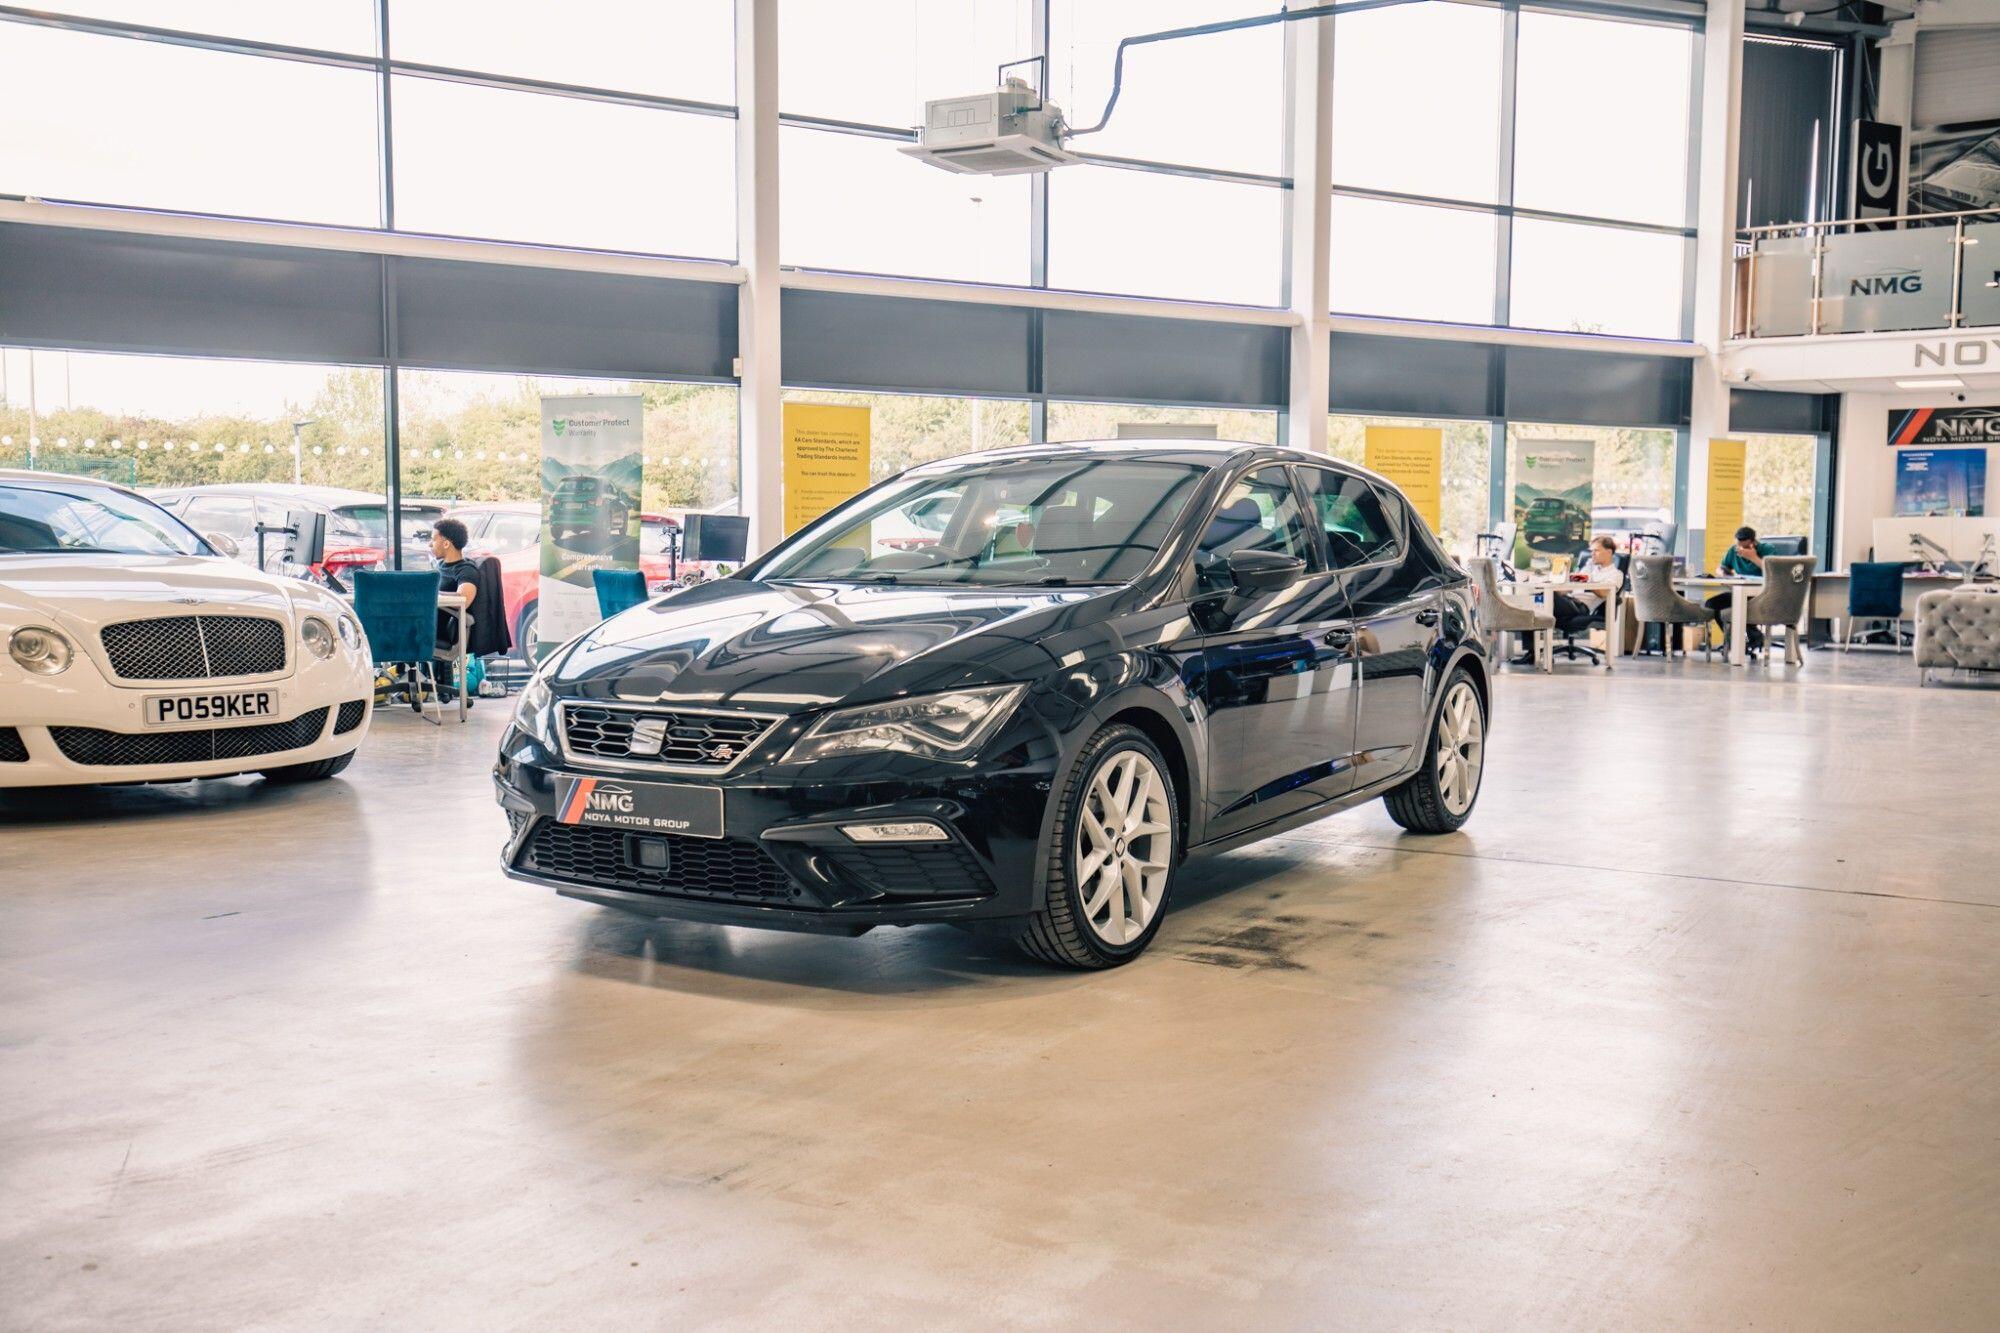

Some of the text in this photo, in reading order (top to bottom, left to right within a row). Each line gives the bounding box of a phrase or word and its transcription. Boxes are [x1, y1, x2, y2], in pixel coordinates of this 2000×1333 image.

[1851, 276, 1922, 296] NMG
[568, 418, 630, 427] Customer Protect
[585, 792, 634, 812] NMG
[584, 812, 690, 829] NOYA MOTOR GROUP
